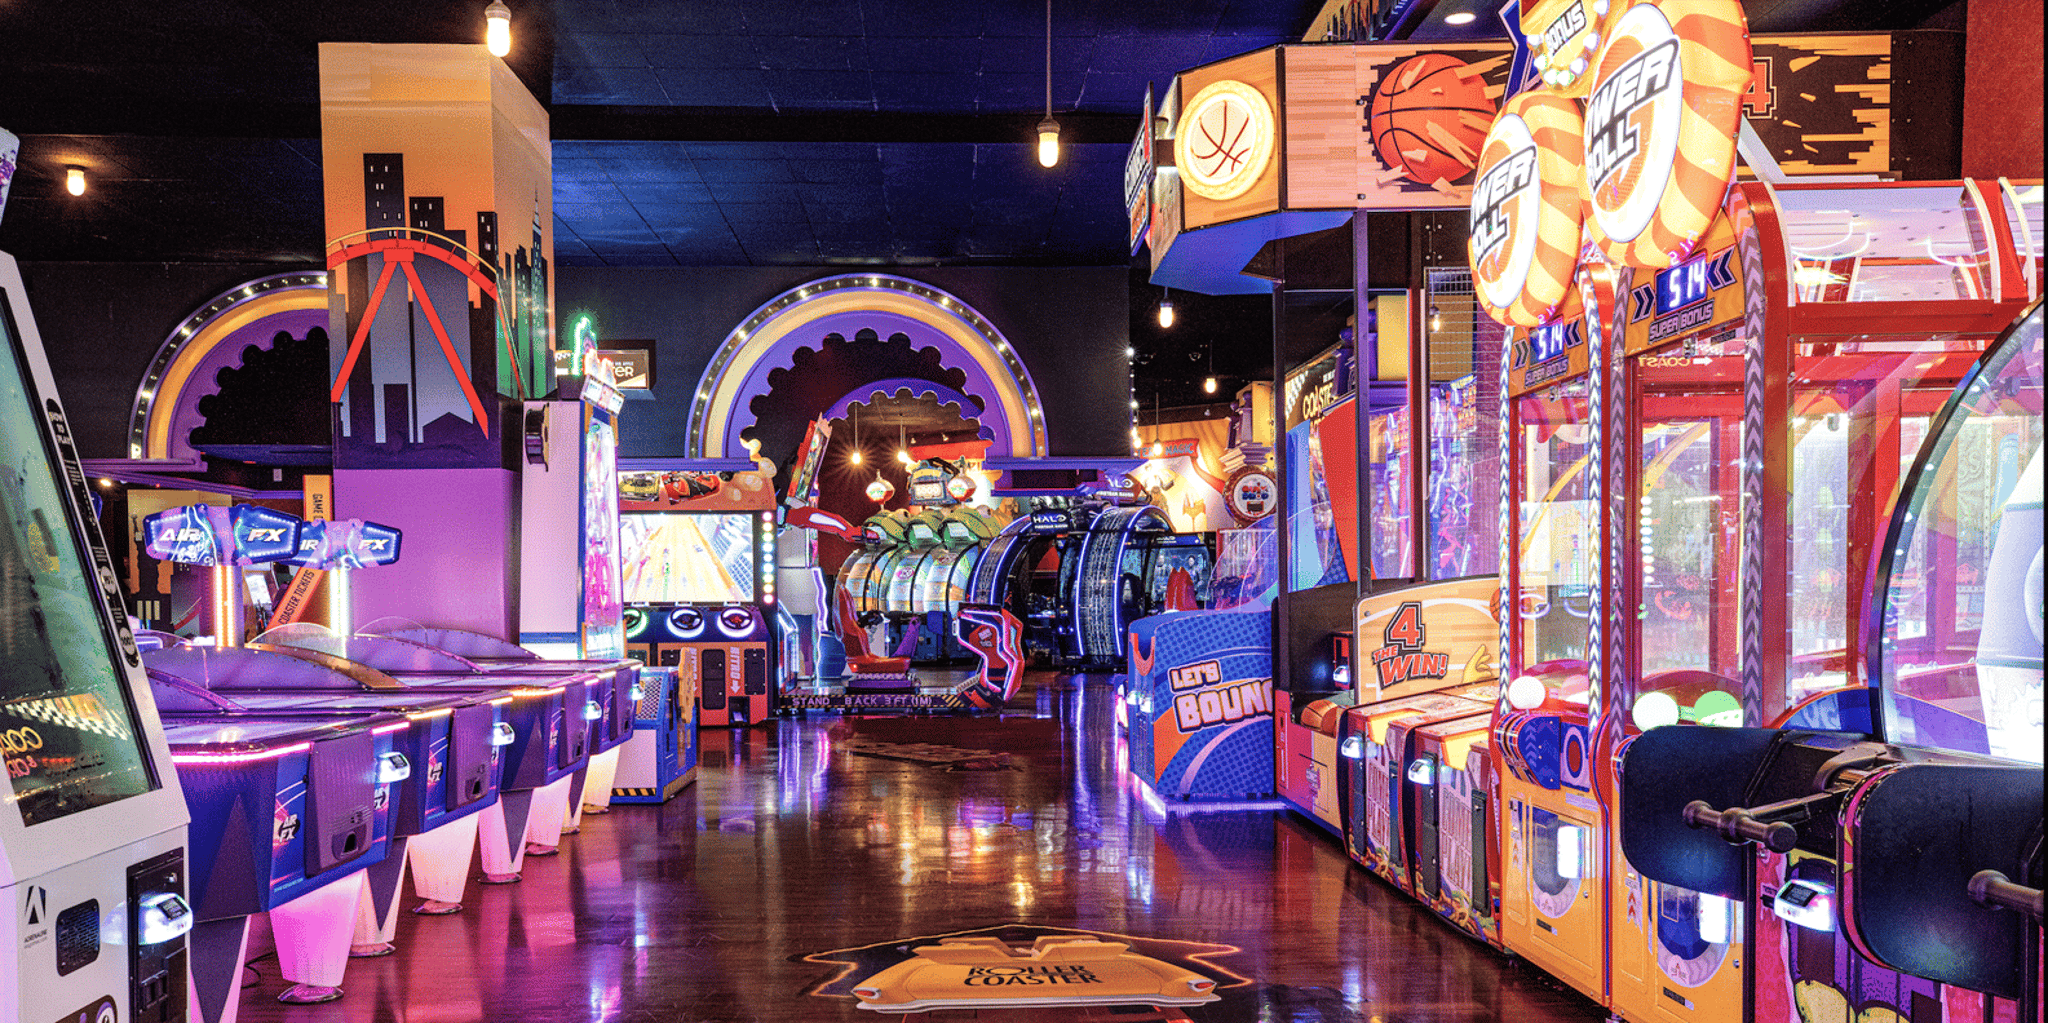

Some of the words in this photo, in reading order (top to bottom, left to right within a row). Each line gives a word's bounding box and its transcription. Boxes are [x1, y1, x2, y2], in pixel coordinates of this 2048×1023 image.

[1650, 316, 1678, 340] SUPER
[1681, 305, 1713, 330] BONUS
[1033, 514, 1067, 524] HALO
[159, 527, 202, 542] AIR
[246, 527, 288, 543] FX
[300, 539, 319, 551] IR
[357, 538, 390, 551] FX
[278, 594, 299, 625] COASTER
[294, 569, 315, 600] TICKETS
[1387, 603, 1424, 649] 4
[1373, 645, 1399, 662] THE
[1171, 660, 1220, 690] LET'S
[1380, 653, 1448, 686] WIN!
[792, 696, 830, 706] STAND
[844, 696, 877, 706] BACK
[968, 965, 1090, 975] ROLLER
[963, 974, 1103, 986] COASTER
